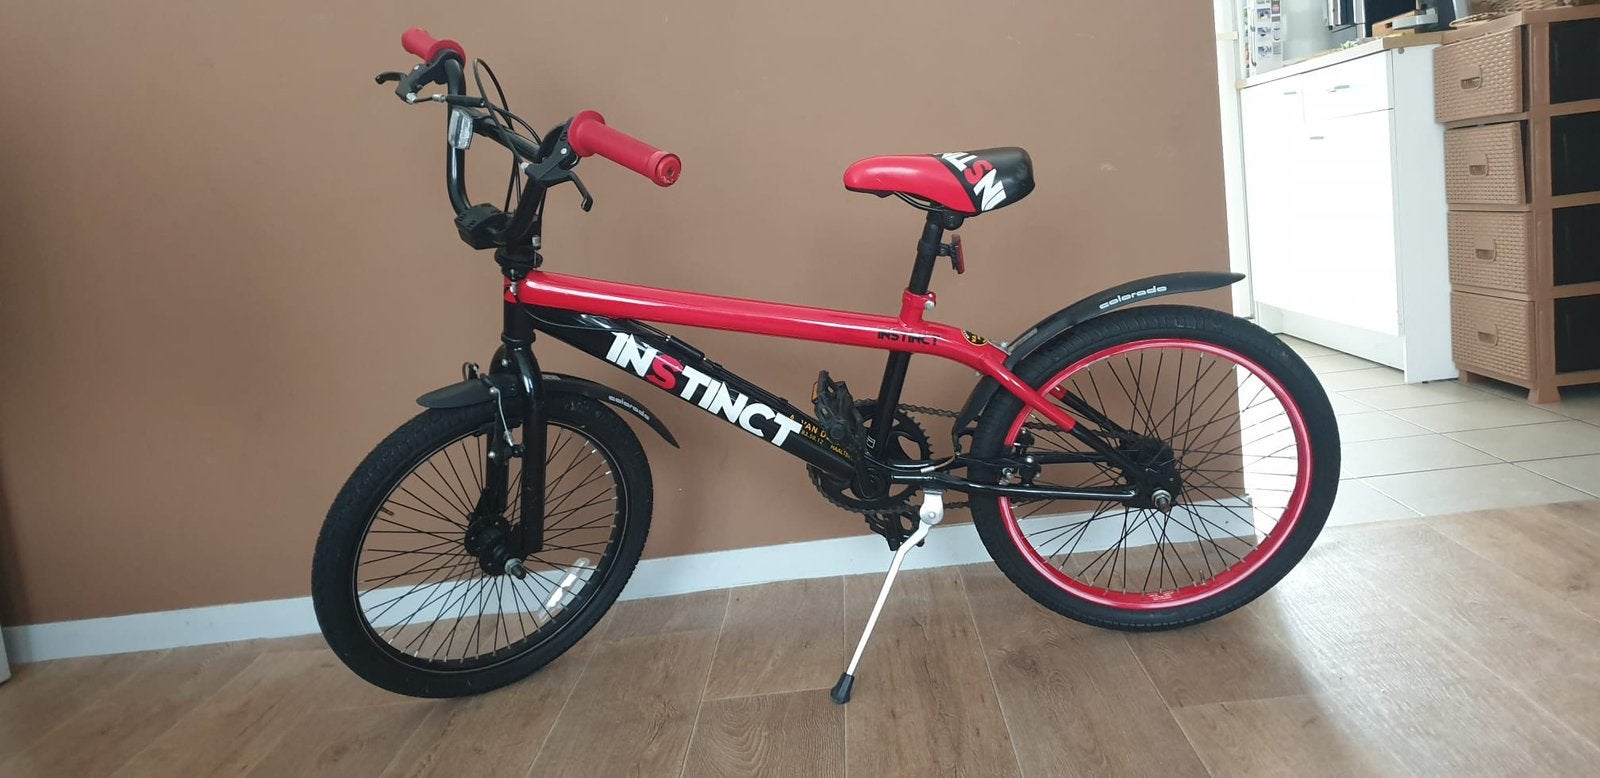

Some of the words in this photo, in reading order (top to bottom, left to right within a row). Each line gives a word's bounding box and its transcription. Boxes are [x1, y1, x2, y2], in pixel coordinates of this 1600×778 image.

[1099, 285, 1168, 310] colorado
[877, 330, 941, 346] INSTINCT
[605, 331, 803, 448] INSTINCT
[608, 395, 650, 421] colorado
